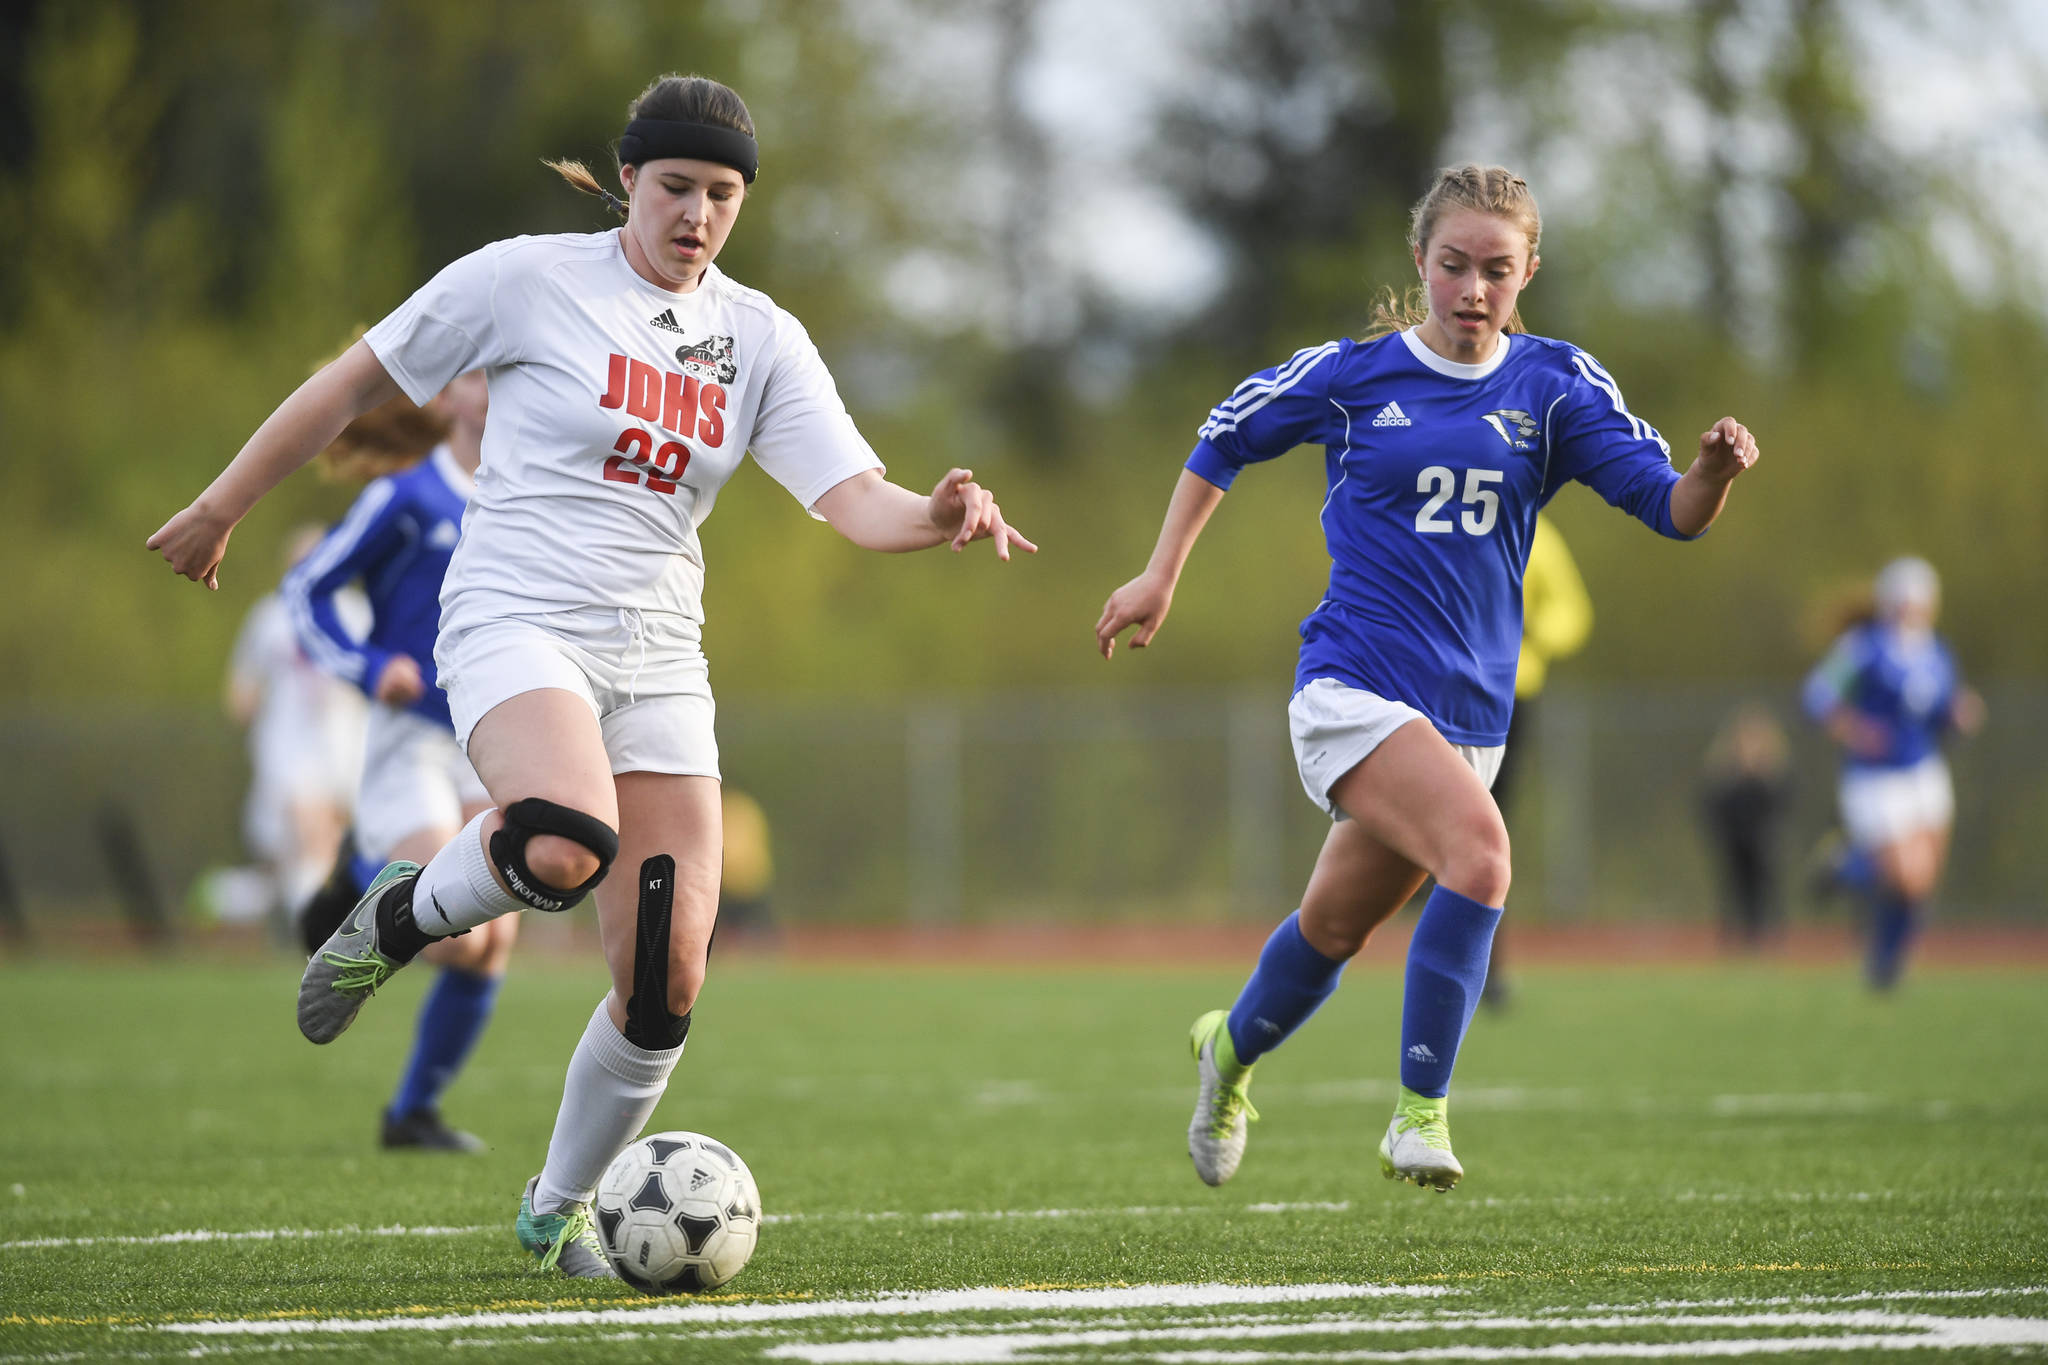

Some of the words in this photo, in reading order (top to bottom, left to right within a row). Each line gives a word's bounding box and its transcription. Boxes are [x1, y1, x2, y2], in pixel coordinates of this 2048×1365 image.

[650, 319, 685, 334] adidas
[599, 353, 726, 448] JDHS
[1372, 417, 1412, 427] adidas
[603, 428, 691, 495] 22
[1415, 466, 1503, 536] 25
[649, 879, 662, 890] KT
